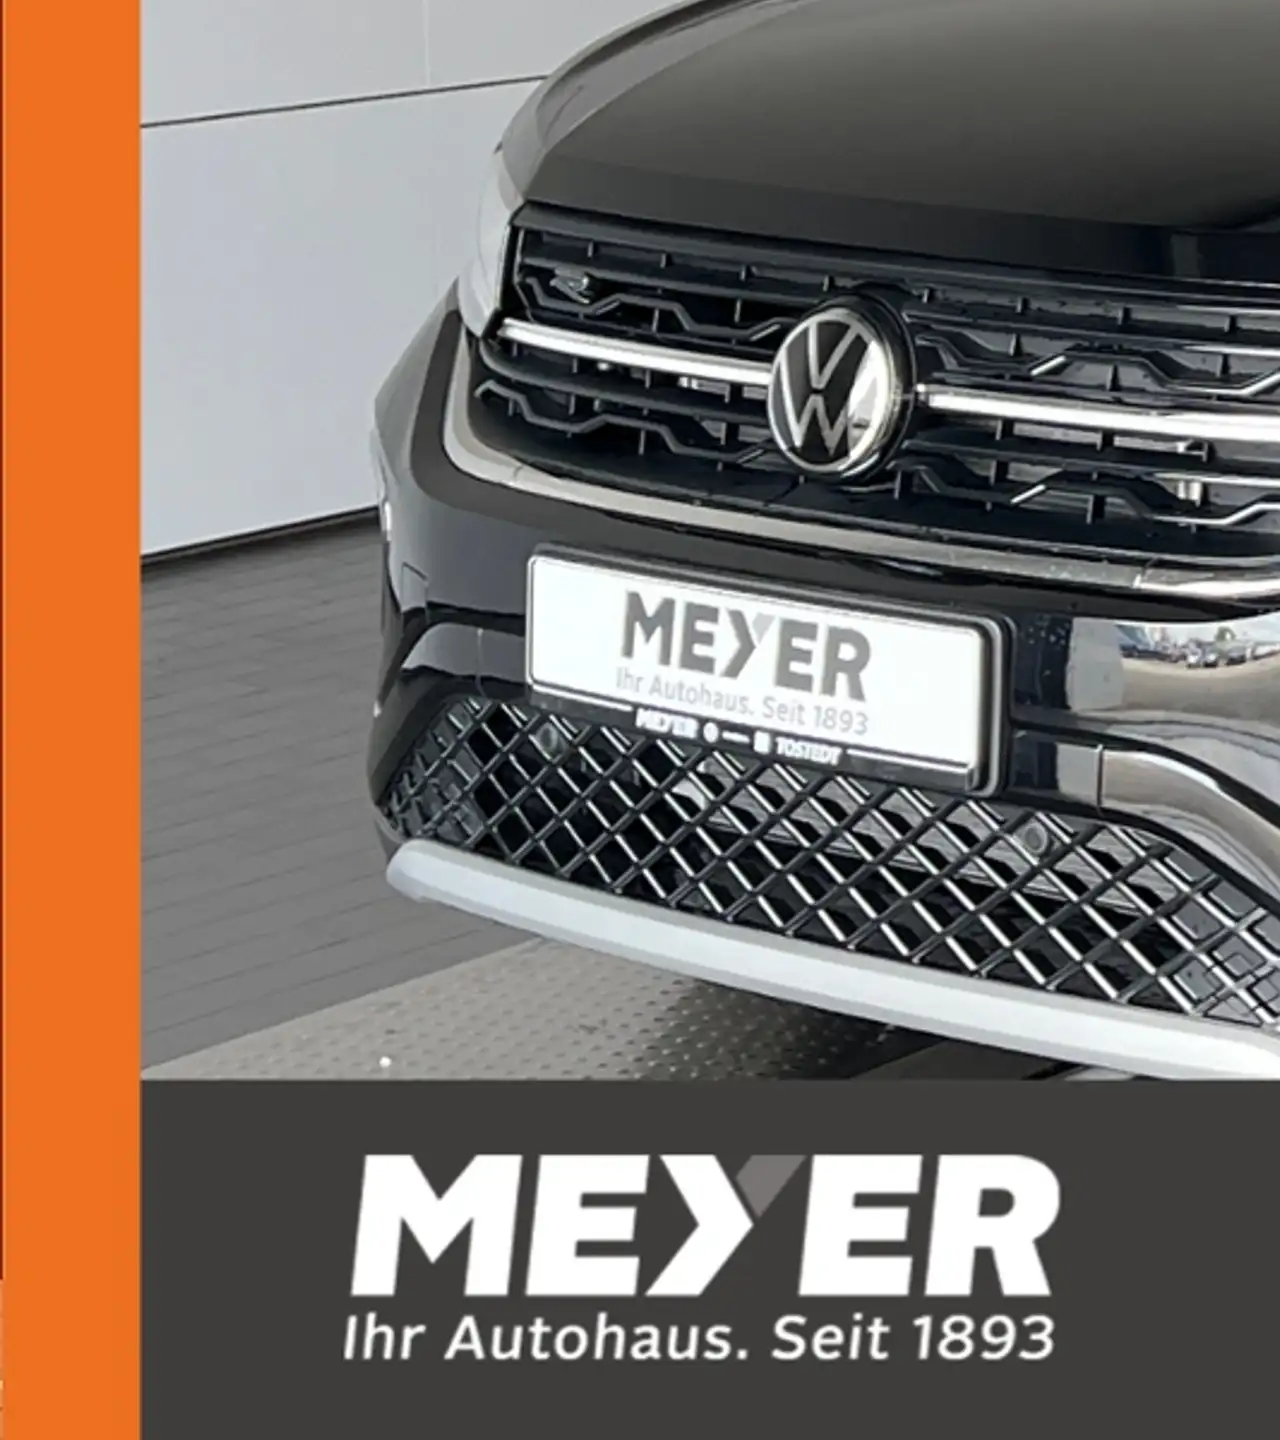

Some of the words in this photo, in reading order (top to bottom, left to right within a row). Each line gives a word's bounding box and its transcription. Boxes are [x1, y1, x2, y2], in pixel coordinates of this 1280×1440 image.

[620, 590, 872, 704] MEYER
[615, 666, 643, 693] Ihr
[648, 674, 756, 717] Autohaus.
[762, 695, 806, 727] Seit
[813, 705, 869, 736] 1893
